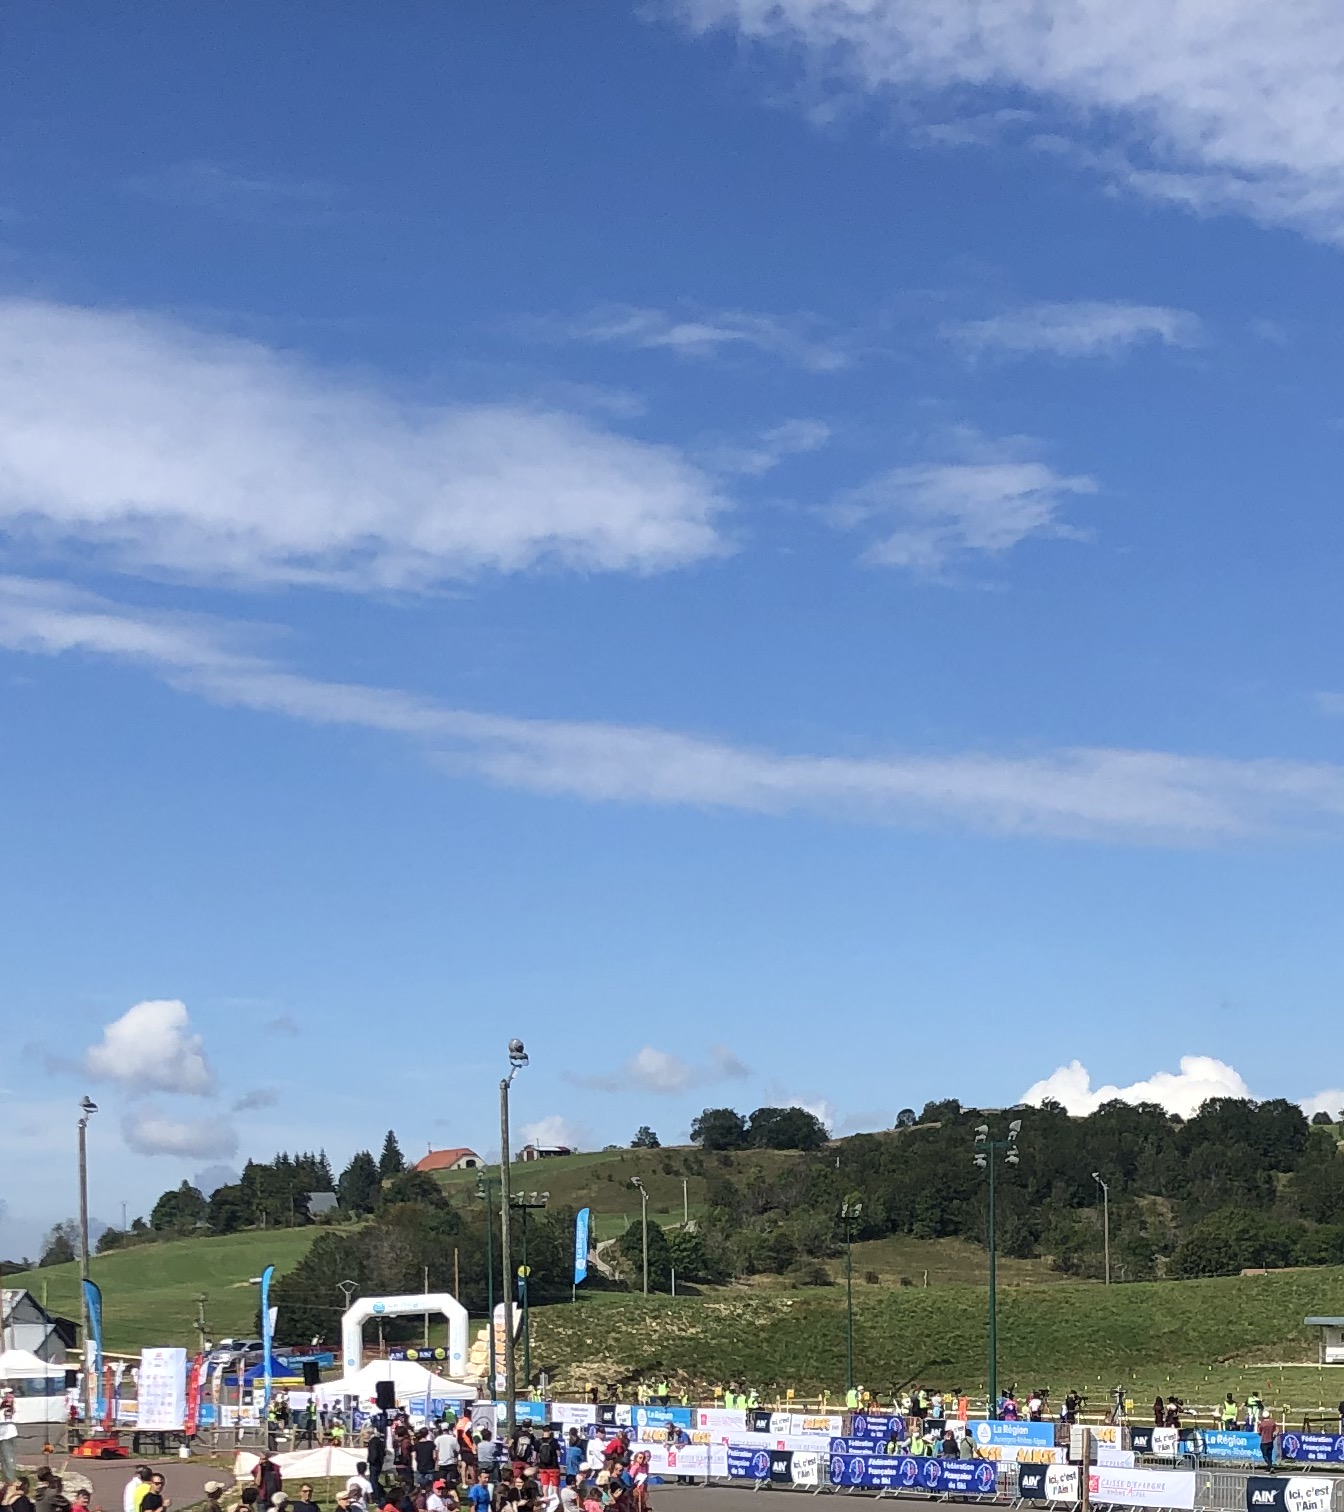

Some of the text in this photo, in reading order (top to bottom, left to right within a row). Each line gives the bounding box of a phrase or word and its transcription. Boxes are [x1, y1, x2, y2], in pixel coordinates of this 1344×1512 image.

[994, 1424, 1029, 1436] La Région
[1206, 1434, 1247, 1447] La Région
[772, 1461, 787, 1472] AIN
[868, 1458, 898, 1466] Fédération
[943, 1462, 975, 1471] Fédération
[868, 1468, 896, 1476] Française
[944, 1471, 972, 1480] Française
[1059, 1472, 1077, 1481] c'est
[956, 1481, 967, 1490] Ski
[1022, 1476, 1038, 1486] AIN
[1101, 1479, 1166, 1490] CAISSE D'EPARGNE
[1053, 1485, 1069, 1495] l'Ain
[1288, 1485, 1329, 1500] Ici, c'est
[1252, 1491, 1275, 1503] AIN
[1296, 1501, 1318, 1511] l'Ain
